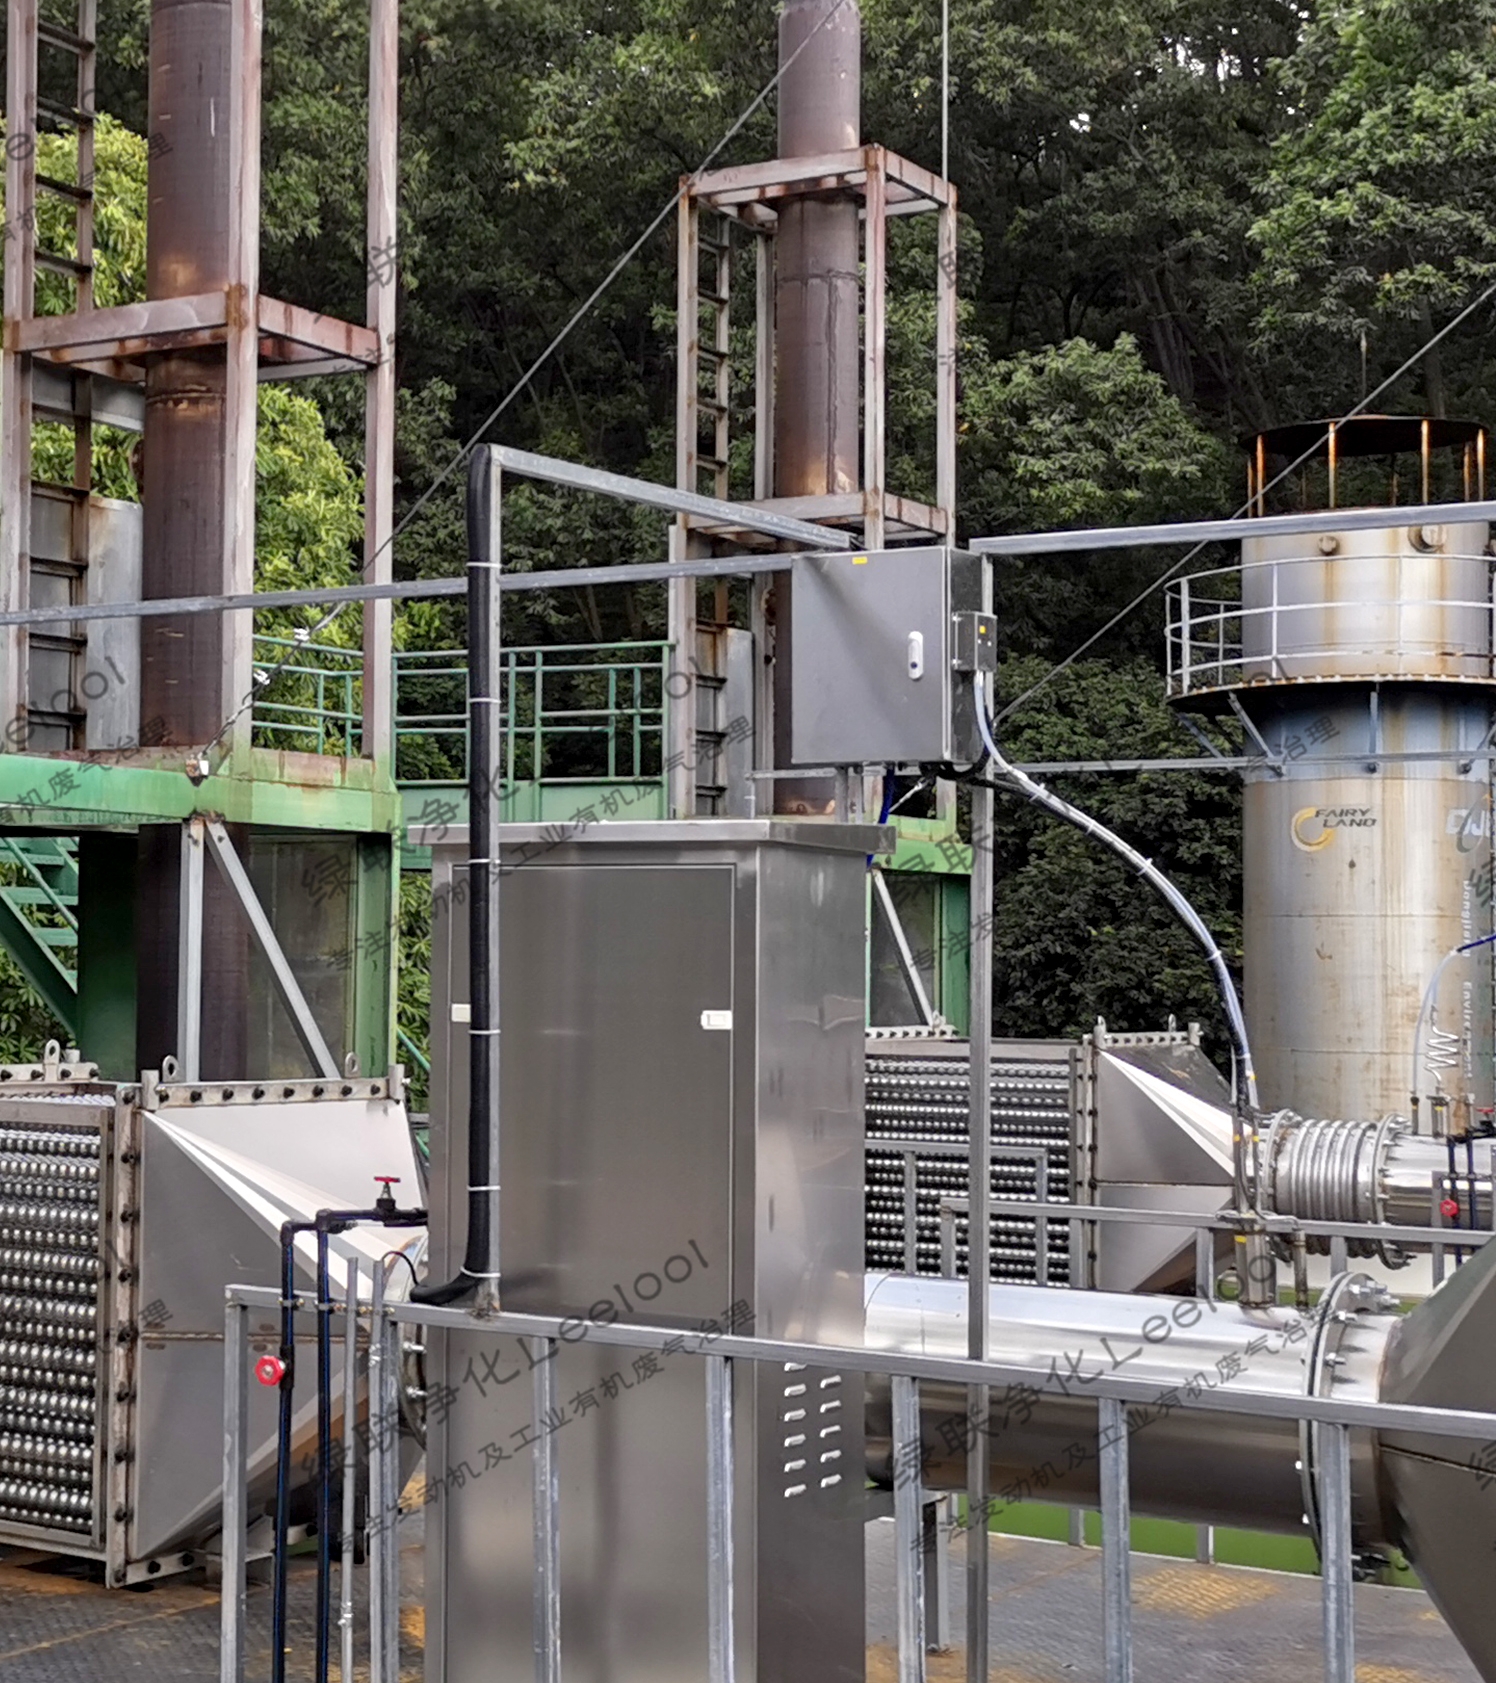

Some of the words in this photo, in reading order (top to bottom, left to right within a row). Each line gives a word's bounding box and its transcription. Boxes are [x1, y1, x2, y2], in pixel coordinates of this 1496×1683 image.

[1315, 807, 1371, 818] FAIRY
[1323, 818, 1377, 829] LAND
[1445, 808, 1490, 837] DJ
